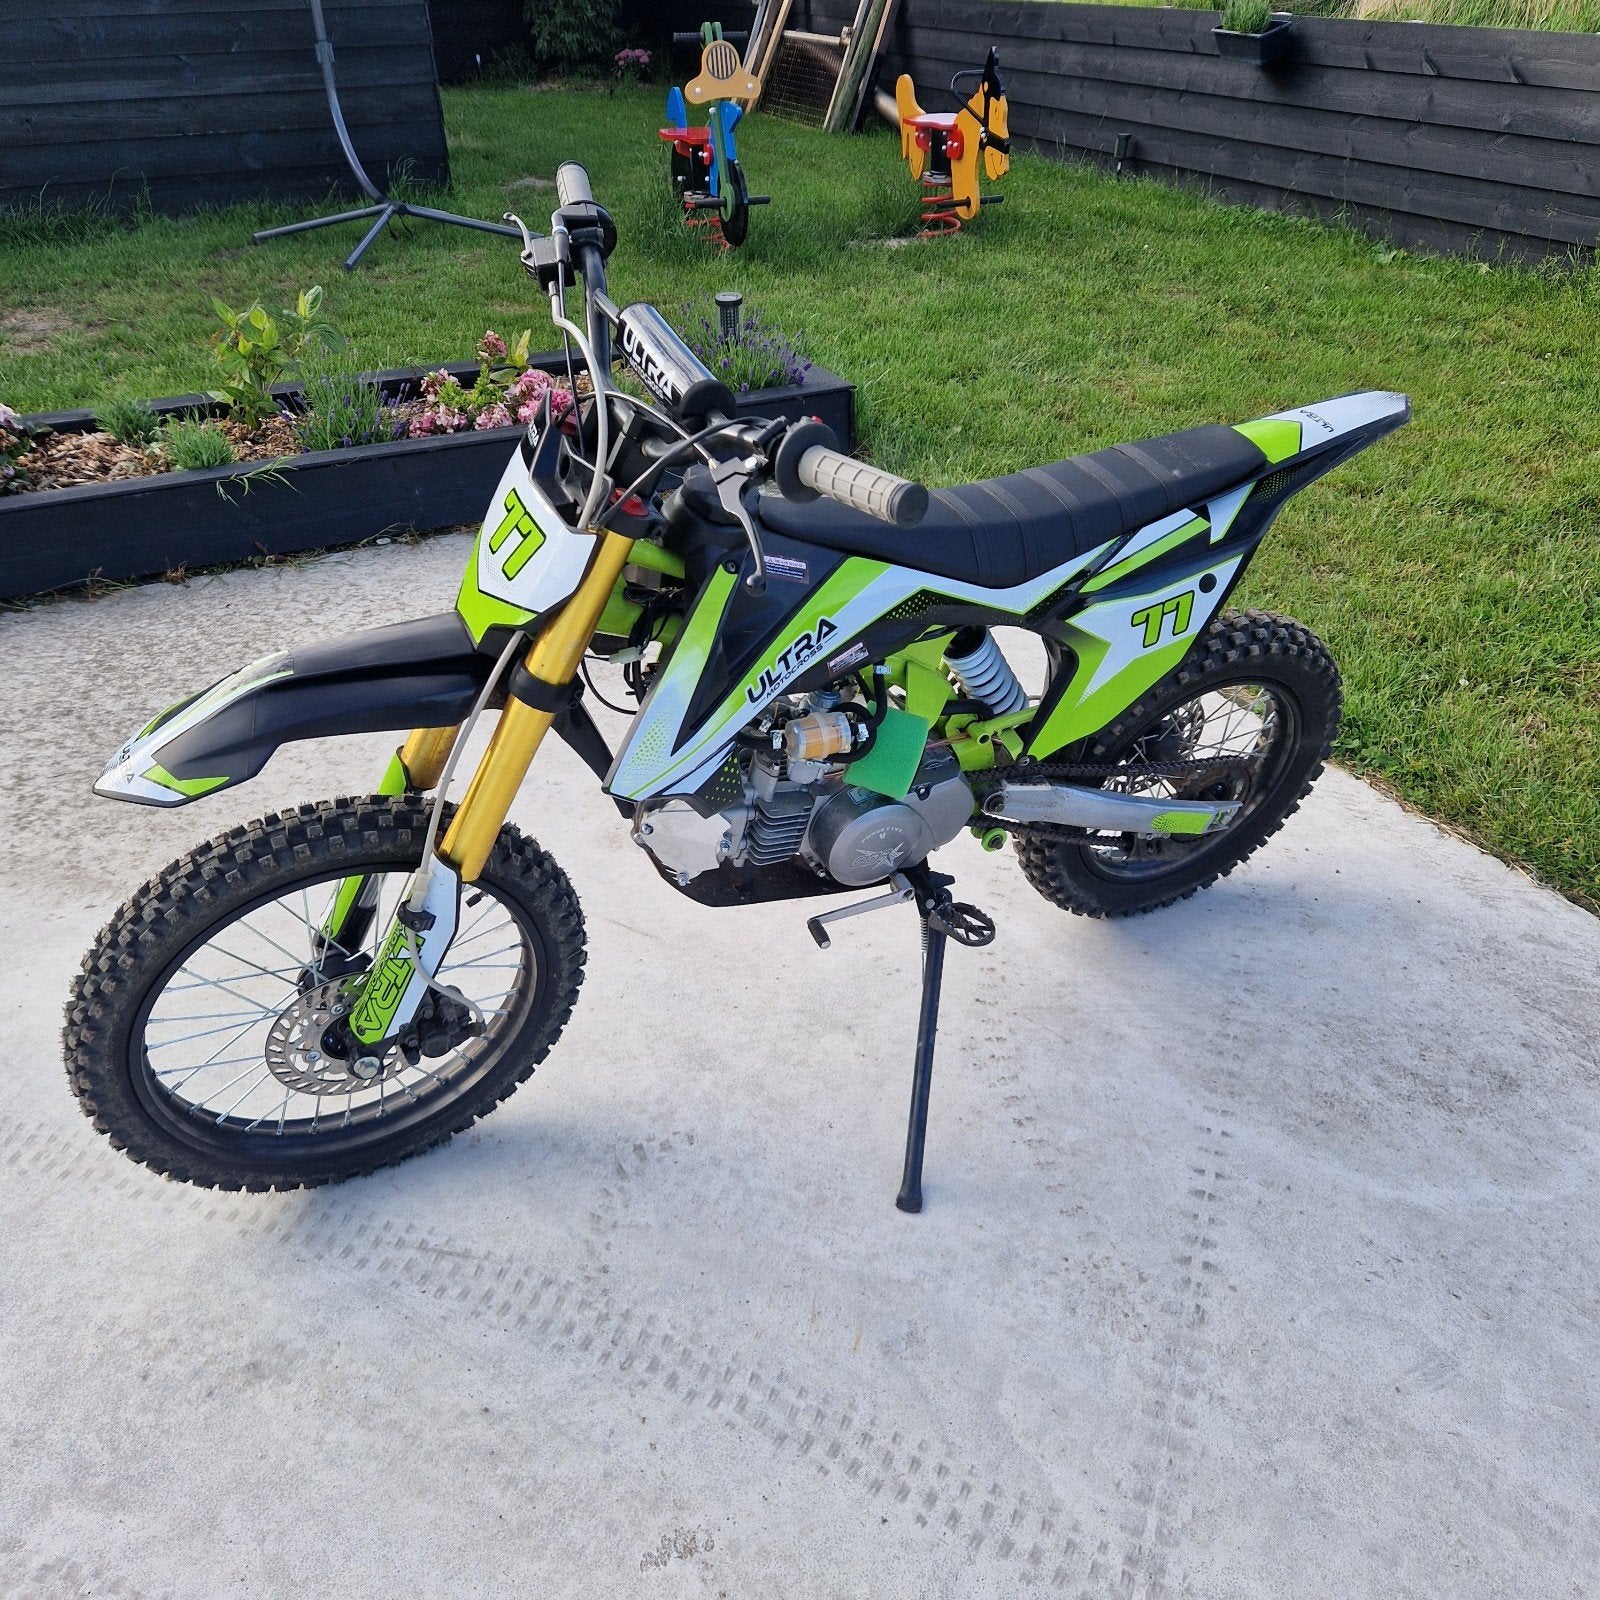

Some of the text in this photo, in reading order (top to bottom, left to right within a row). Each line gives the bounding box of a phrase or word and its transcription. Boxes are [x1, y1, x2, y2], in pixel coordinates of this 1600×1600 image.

[621, 320, 677, 401] ULTRA
[1300, 409, 1334, 433] ULTRA
[488, 487, 547, 582] 77
[1131, 589, 1195, 648] 77
[746, 618, 838, 703] ULTRA
[766, 643, 824, 698] MOTOCROSS
